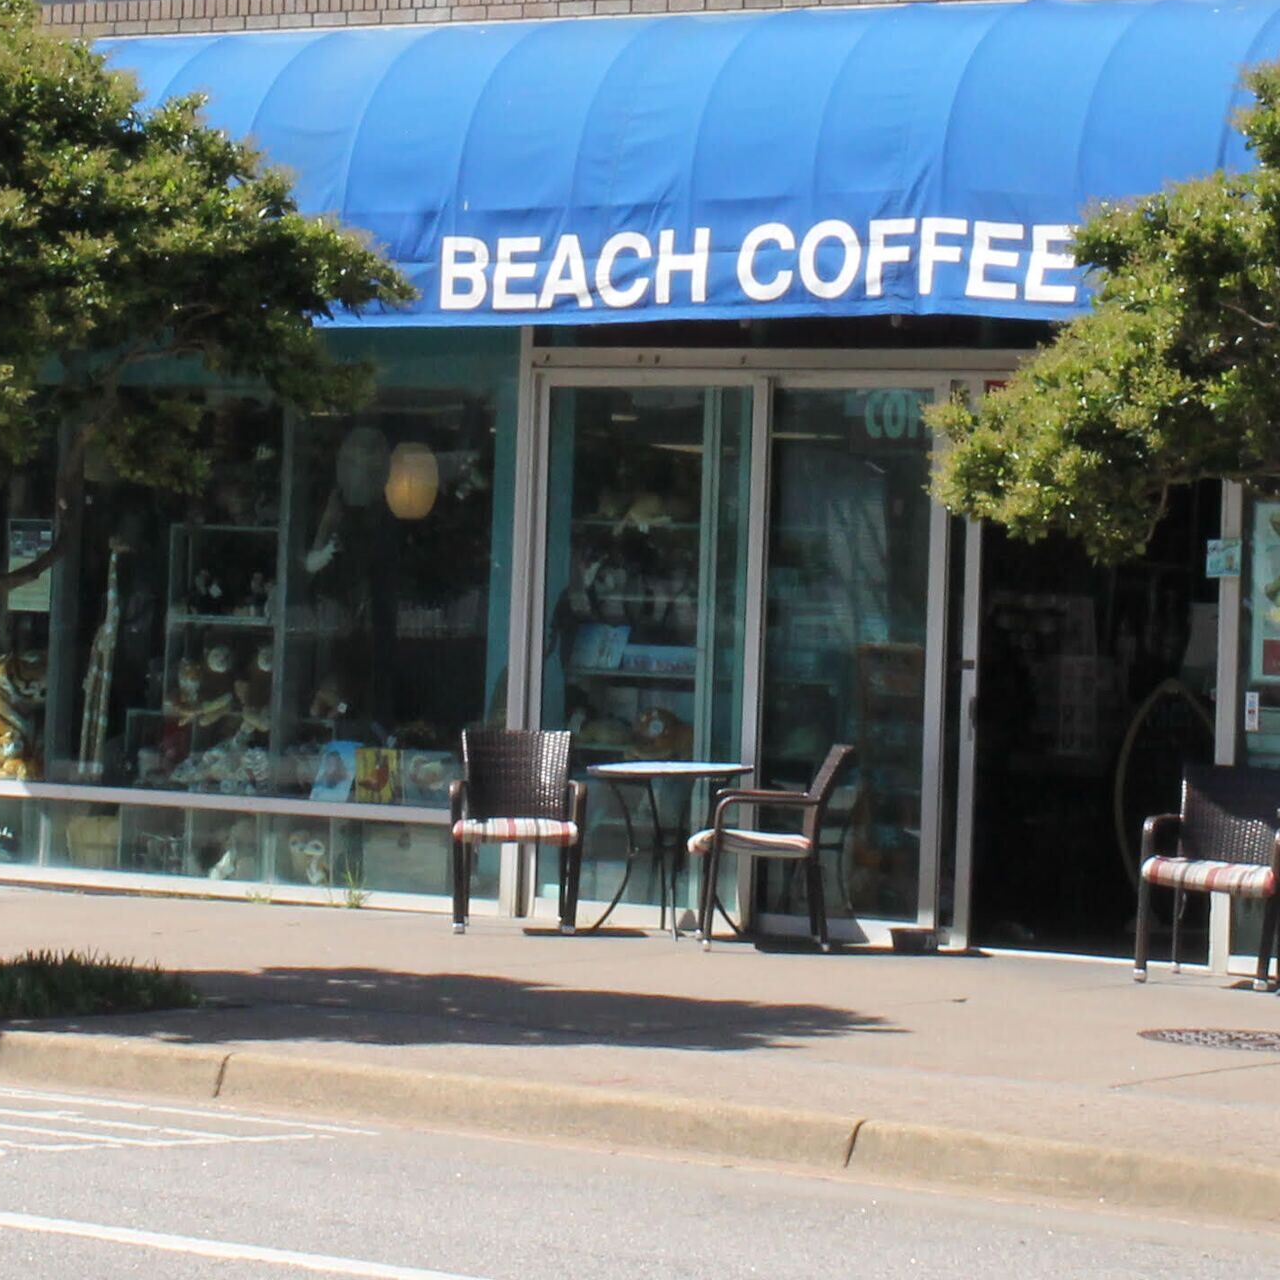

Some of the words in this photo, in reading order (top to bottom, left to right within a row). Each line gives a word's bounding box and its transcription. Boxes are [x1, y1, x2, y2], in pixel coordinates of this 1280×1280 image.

[439, 226, 710, 310] BEACH
[735, 216, 1078, 304] COFFEE
[864, 389, 924, 439] COF
